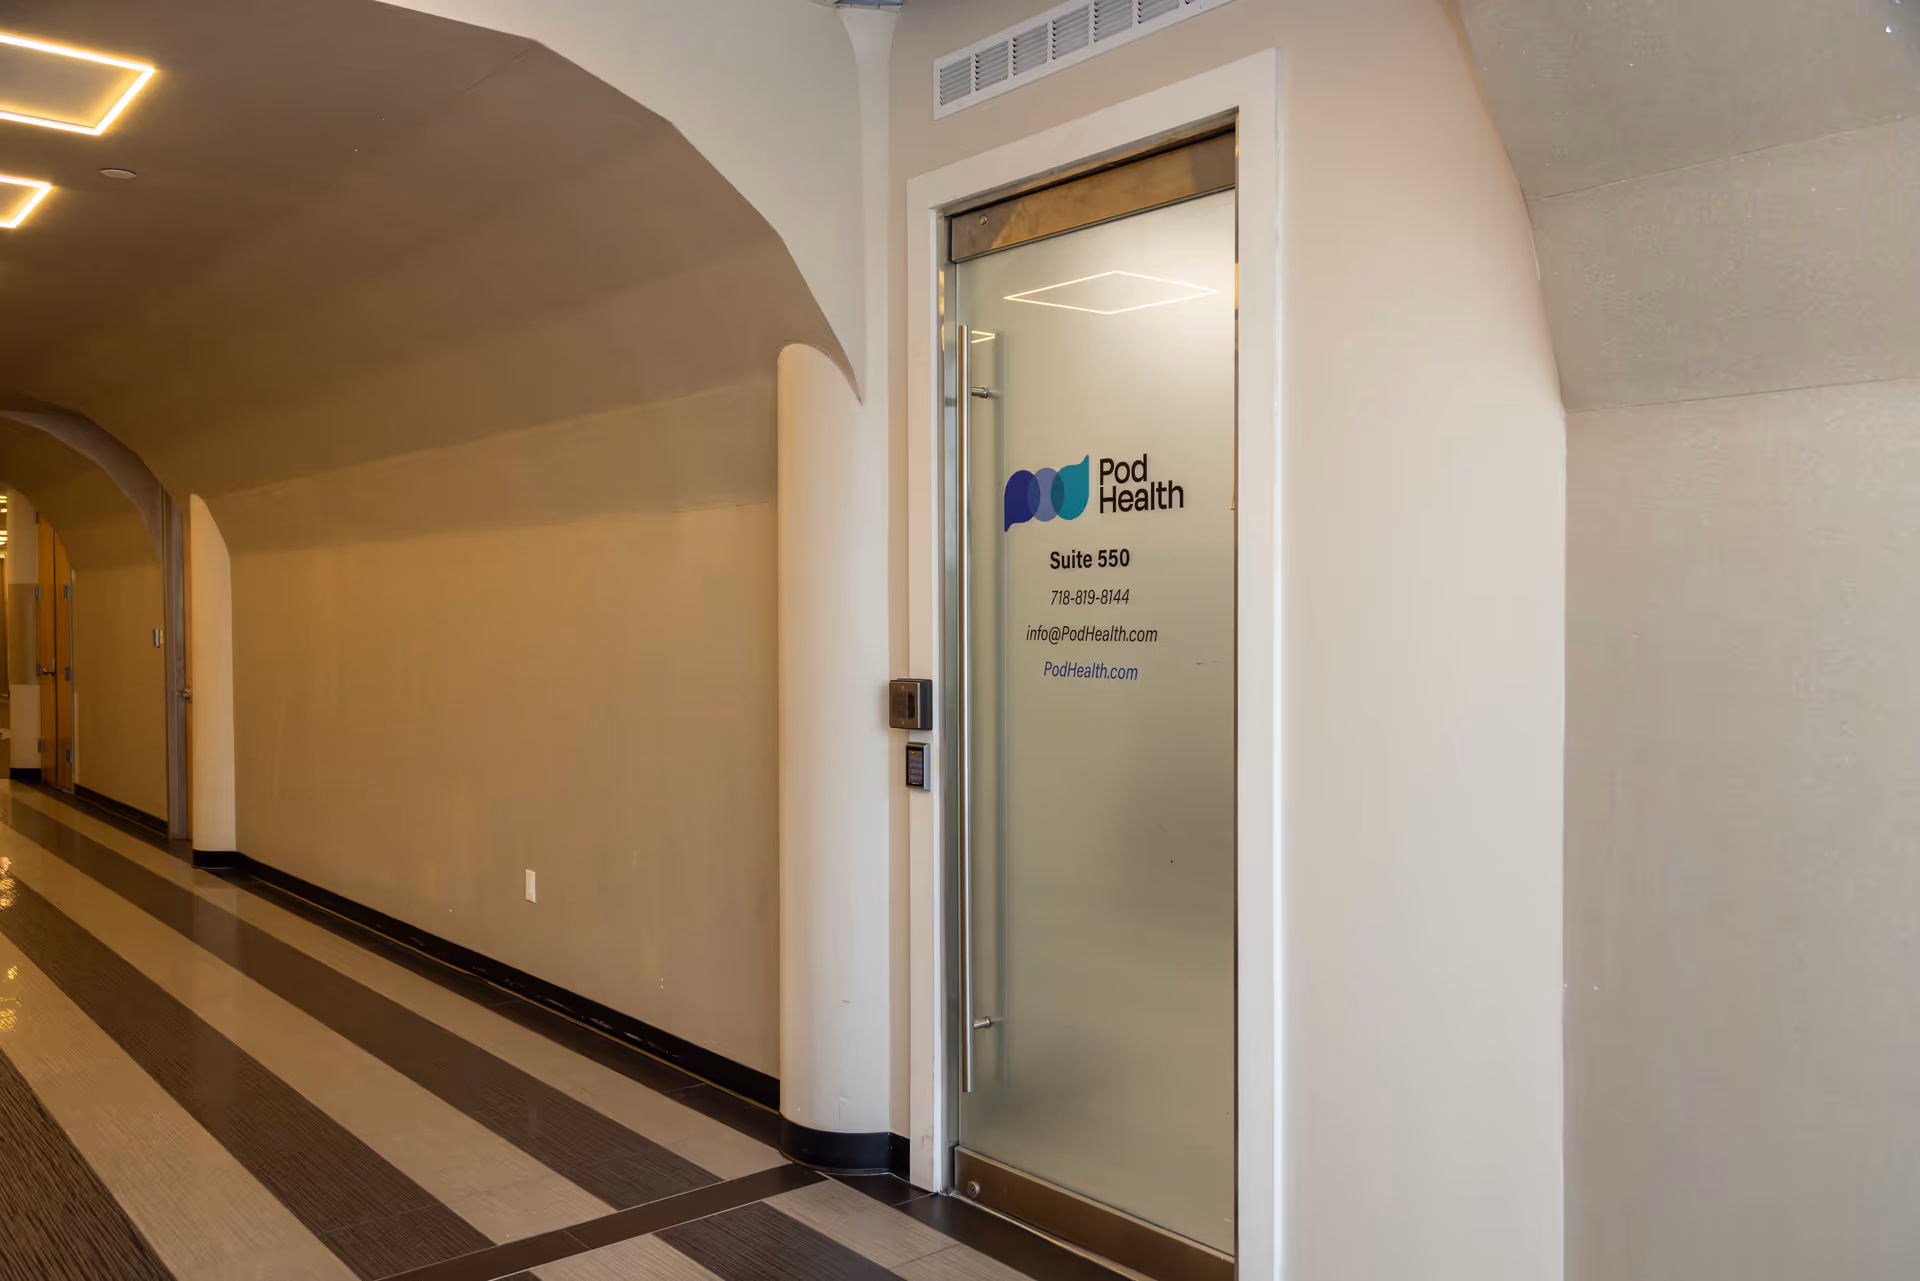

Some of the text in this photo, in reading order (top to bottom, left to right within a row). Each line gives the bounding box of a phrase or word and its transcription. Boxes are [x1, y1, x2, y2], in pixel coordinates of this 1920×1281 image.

[1099, 453, 1148, 485] Pod
[1099, 480, 1184, 514] Health
[1050, 548, 1130, 569] Suite 550
[1050, 588, 1130, 605] 718-819-8144
[1026, 624, 1158, 645] info@PodHealth.com
[1043, 661, 1138, 681] PodHealth.com
